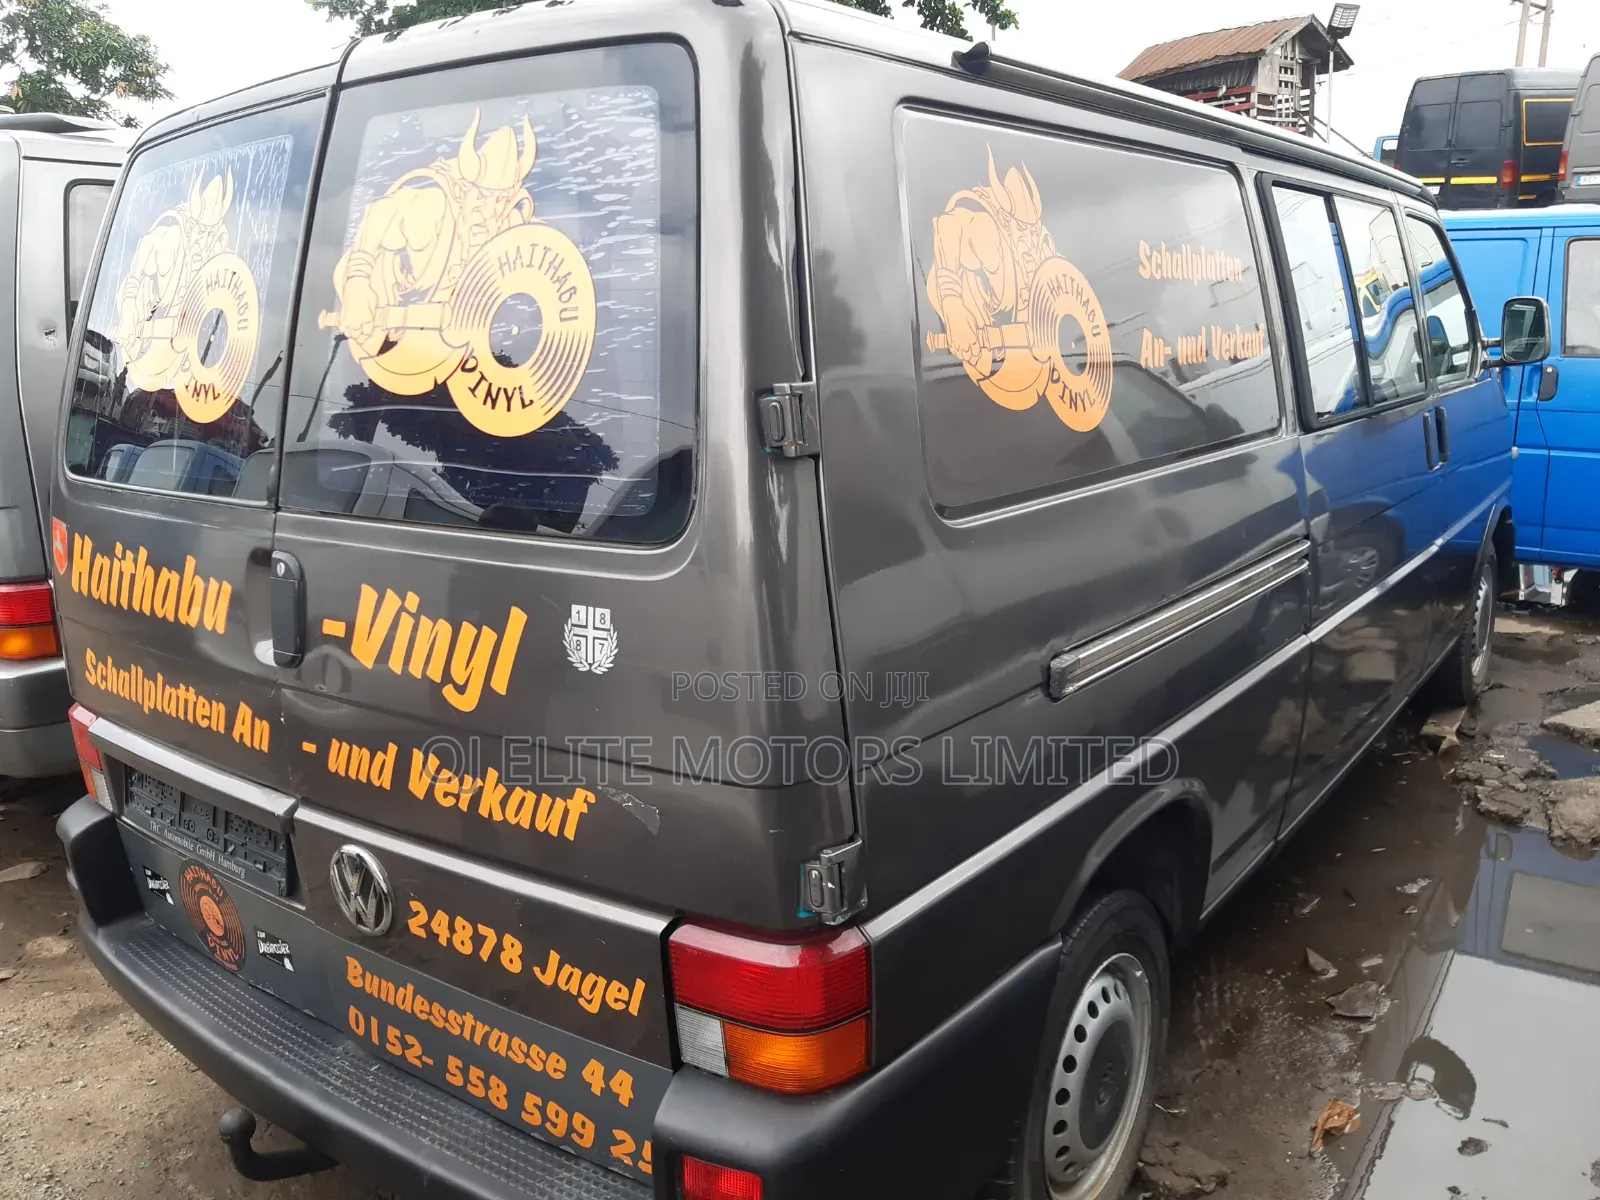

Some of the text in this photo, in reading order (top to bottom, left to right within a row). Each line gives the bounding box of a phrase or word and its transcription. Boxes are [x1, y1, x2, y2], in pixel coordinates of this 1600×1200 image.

[205, 268, 249, 331] HAITHABU
[498, 243, 579, 323] HAITHABU
[1138, 239, 1243, 287] Schallplatten
[1047, 273, 1102, 338] HAITHABU
[1140, 323, 1265, 369] An- und Verkauf
[71, 532, 528, 713] Haithabu -Vinyl
[85, 647, 226, 735] Schallplatten
[232, 701, 270, 753] An
[327, 738, 398, 790] und
[408, 747, 596, 842] Verkauf
[150, 820, 246, 878] TRC Automobile GmbH Hamburg
[408, 900, 646, 1017] 24878 Jagel
[345, 955, 635, 1108] Bundesstrasse 44
[445, 1055, 509, 1110] 558
[521, 1092, 595, 1148] 599
